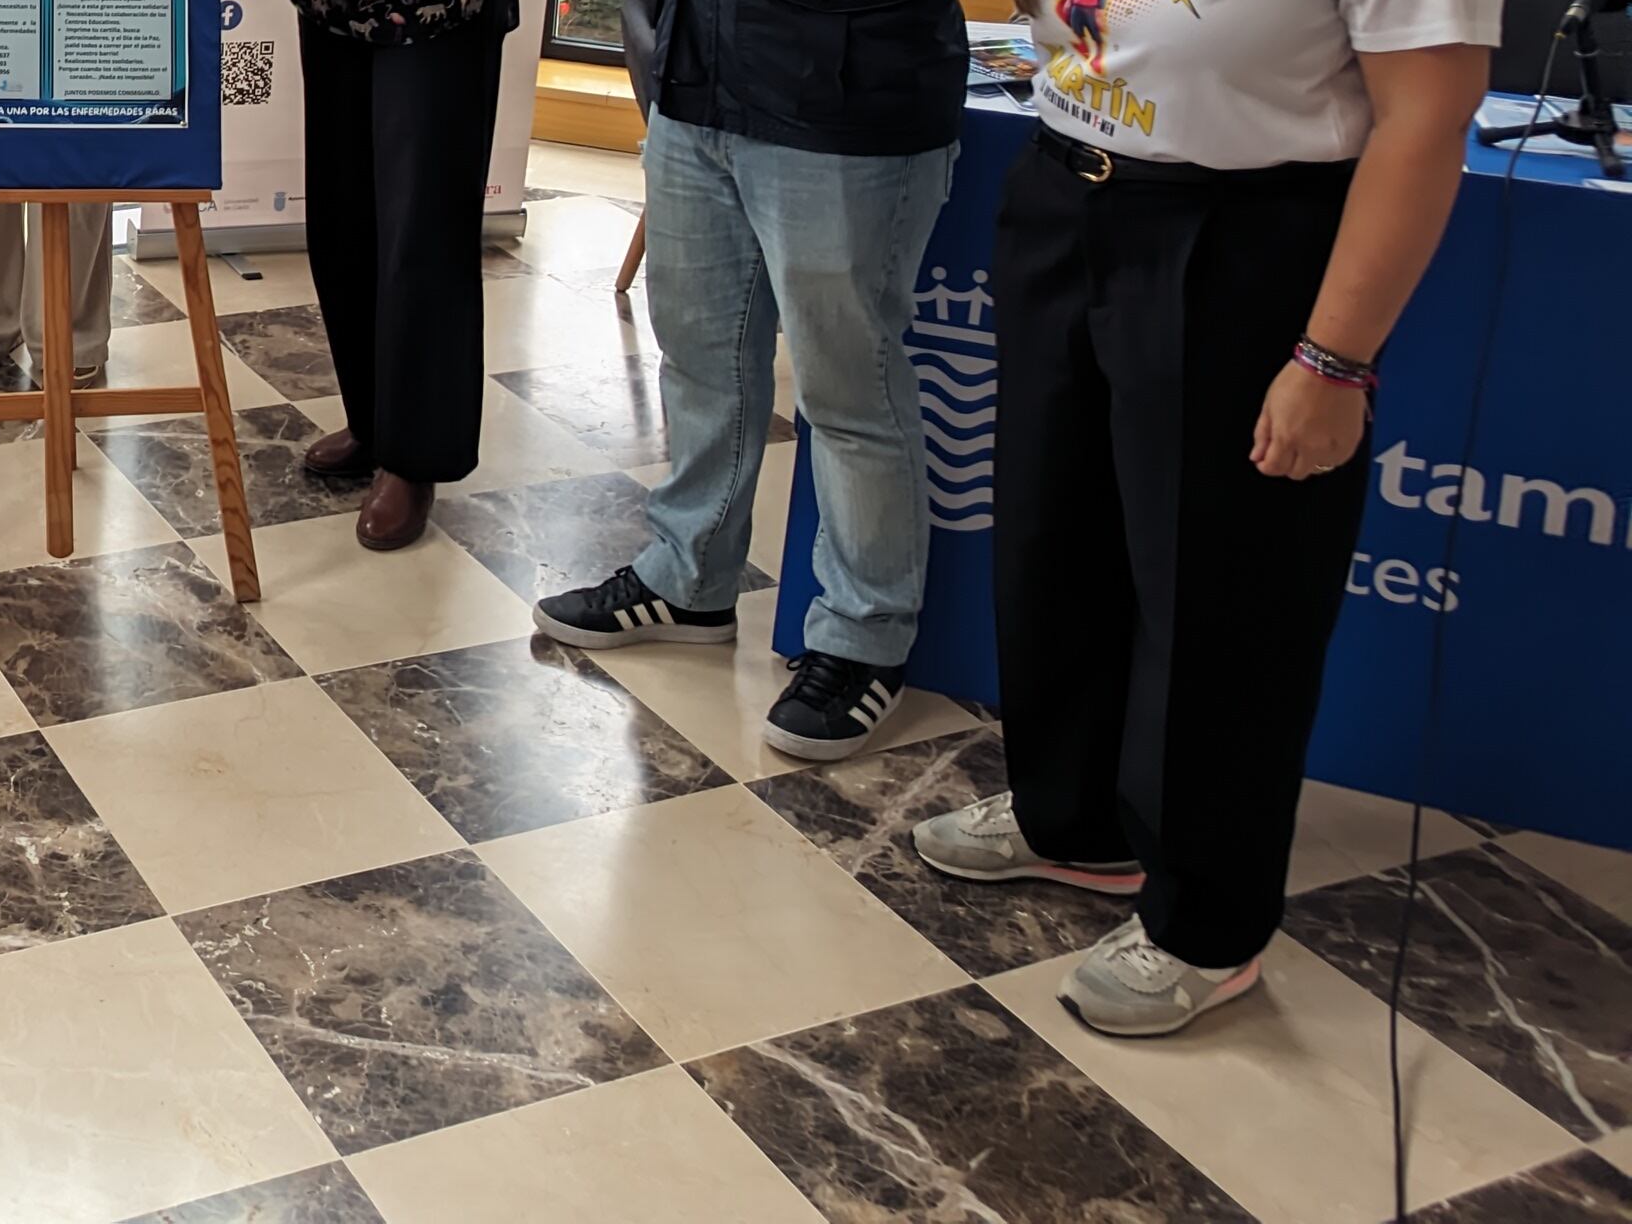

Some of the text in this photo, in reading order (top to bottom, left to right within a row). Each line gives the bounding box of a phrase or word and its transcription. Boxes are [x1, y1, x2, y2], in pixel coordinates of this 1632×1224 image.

[6, 107, 28, 116] UNA
[29, 107, 49, 116] POR
[51, 107, 69, 116] LAS
[71, 107, 143, 116] ENFERMEDADES
[145, 107, 178, 116] RARAS
